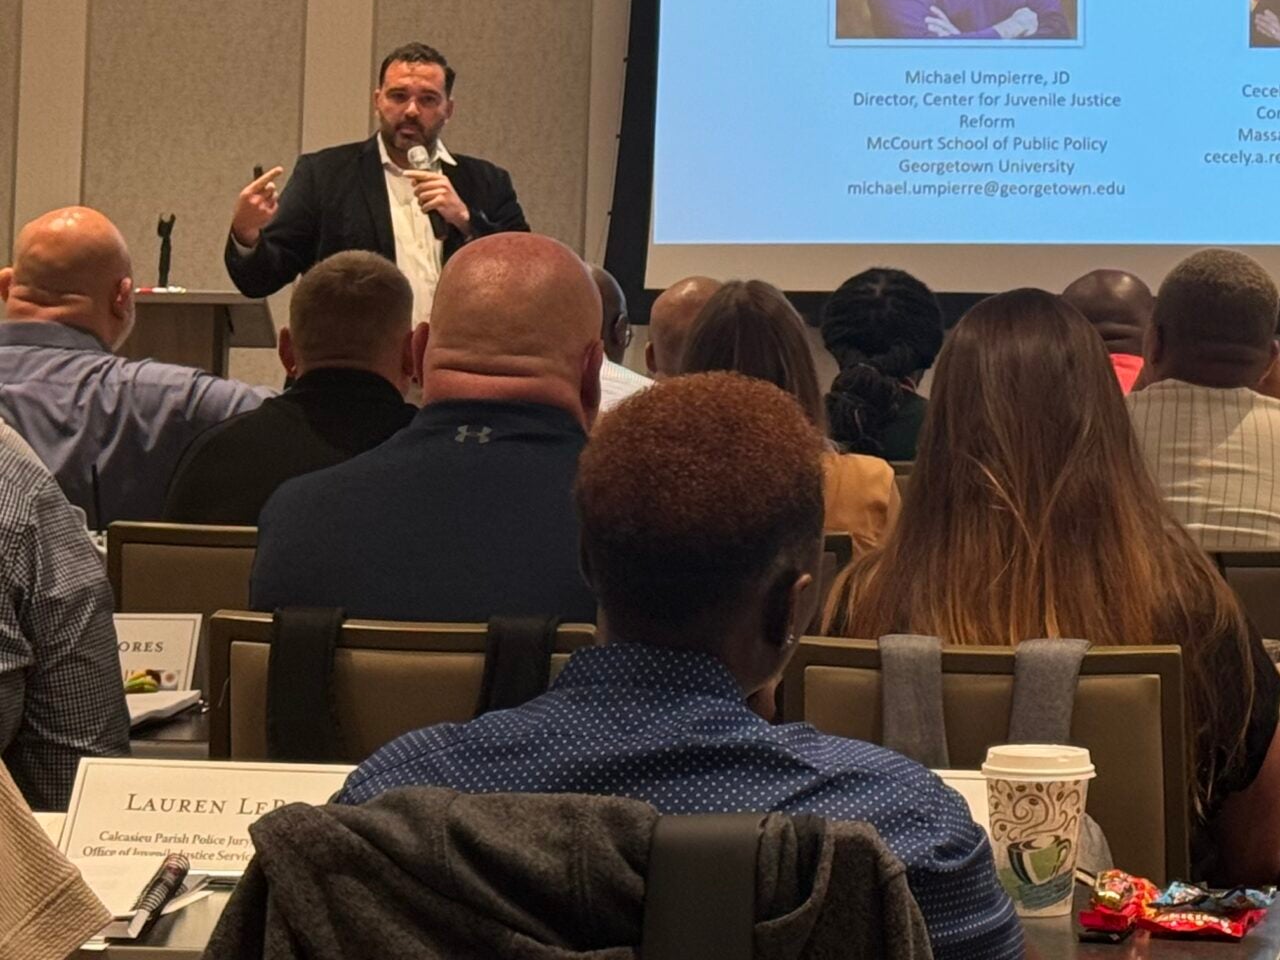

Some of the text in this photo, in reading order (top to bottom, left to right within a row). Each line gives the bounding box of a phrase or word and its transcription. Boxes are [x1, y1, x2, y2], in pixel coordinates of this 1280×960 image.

[905, 70, 1070, 88] Michael Umpierre, JD
[853, 91, 1121, 108] Director, Center for Juvenile Justice
[959, 114, 1015, 128] Reform
[866, 136, 1108, 153] McCourt School of Public Policy
[898, 158, 1075, 176] Georgetown University
[847, 180, 1126, 198] michael.umpierre@georgetown.edu
[125, 793, 228, 815] LAUREN
[99, 830, 153, 843] Calcasieu
[154, 832, 189, 844] Parish
[191, 833, 226, 846] Police
[82, 845, 117, 857] Office
[118, 847, 132, 856] of
